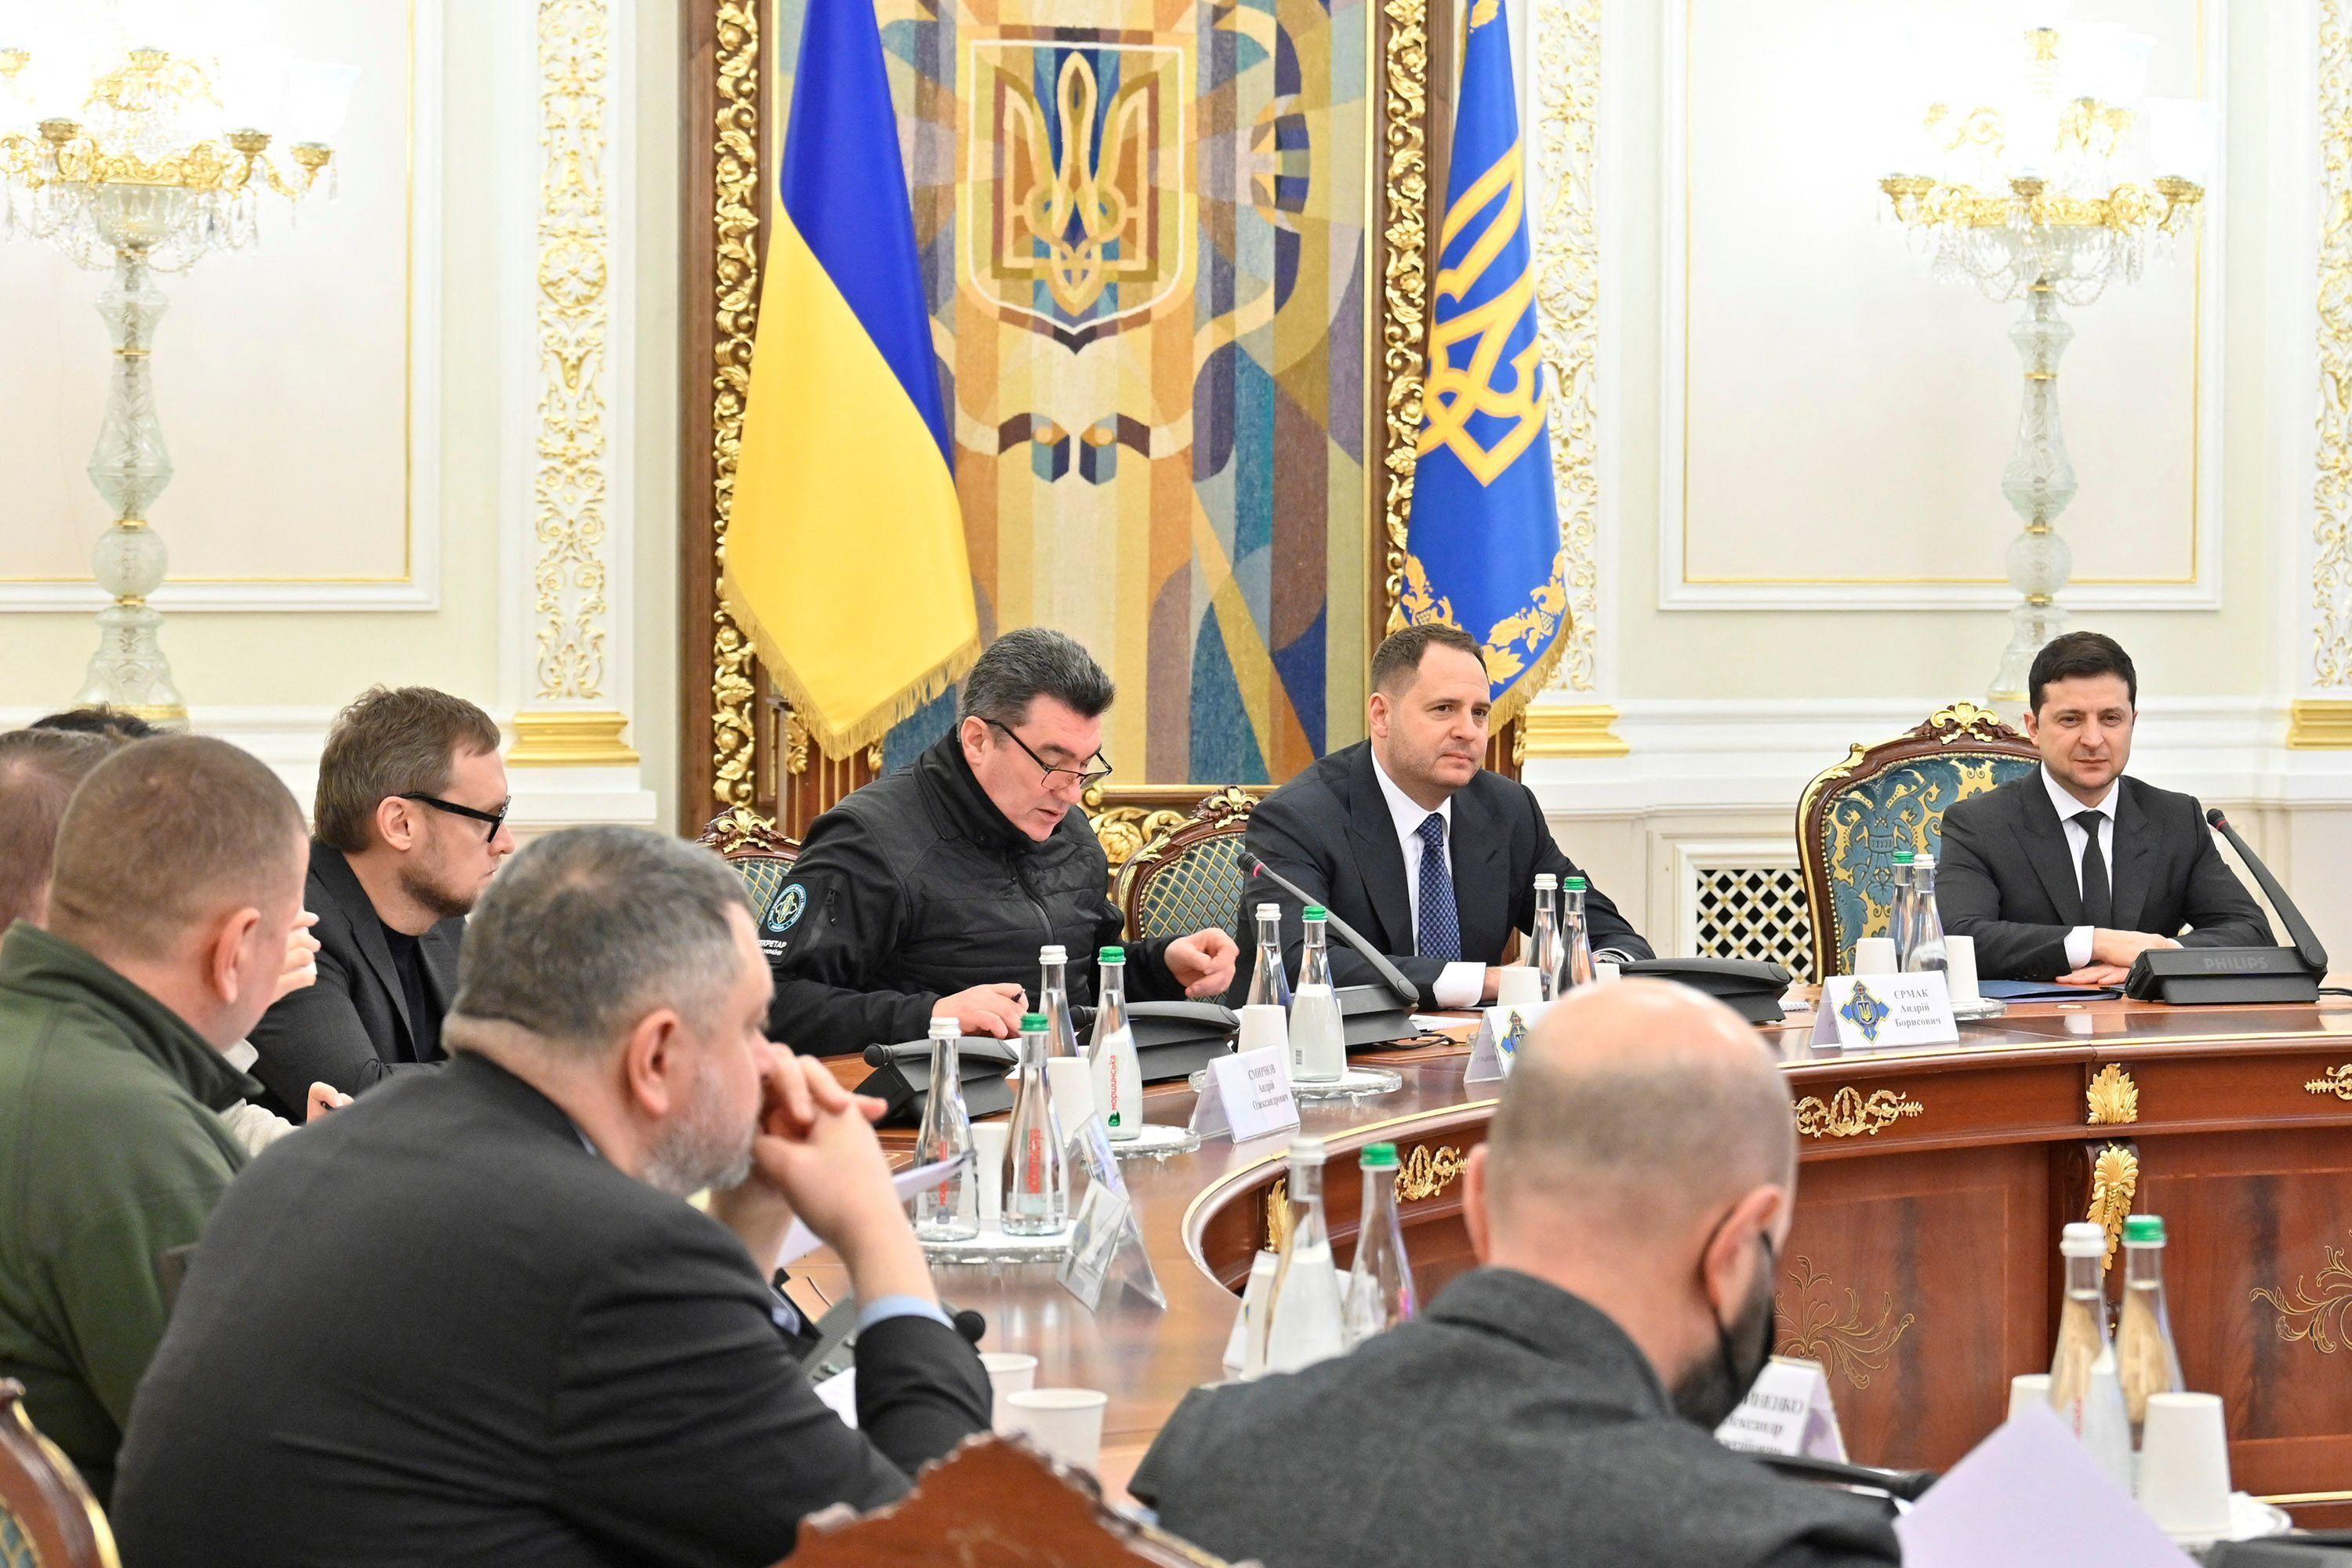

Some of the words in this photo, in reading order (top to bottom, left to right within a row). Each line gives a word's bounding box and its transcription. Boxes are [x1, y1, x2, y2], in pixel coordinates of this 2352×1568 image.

[2204, 956, 2269, 970] PHILIPS
[1900, 1003, 1930, 1014] Андрій
[1894, 1018, 1942, 1029] Борисович
[1248, 1064, 1276, 1080] СМИРНОВ
[1109, 1054, 1119, 1110] моршинська
